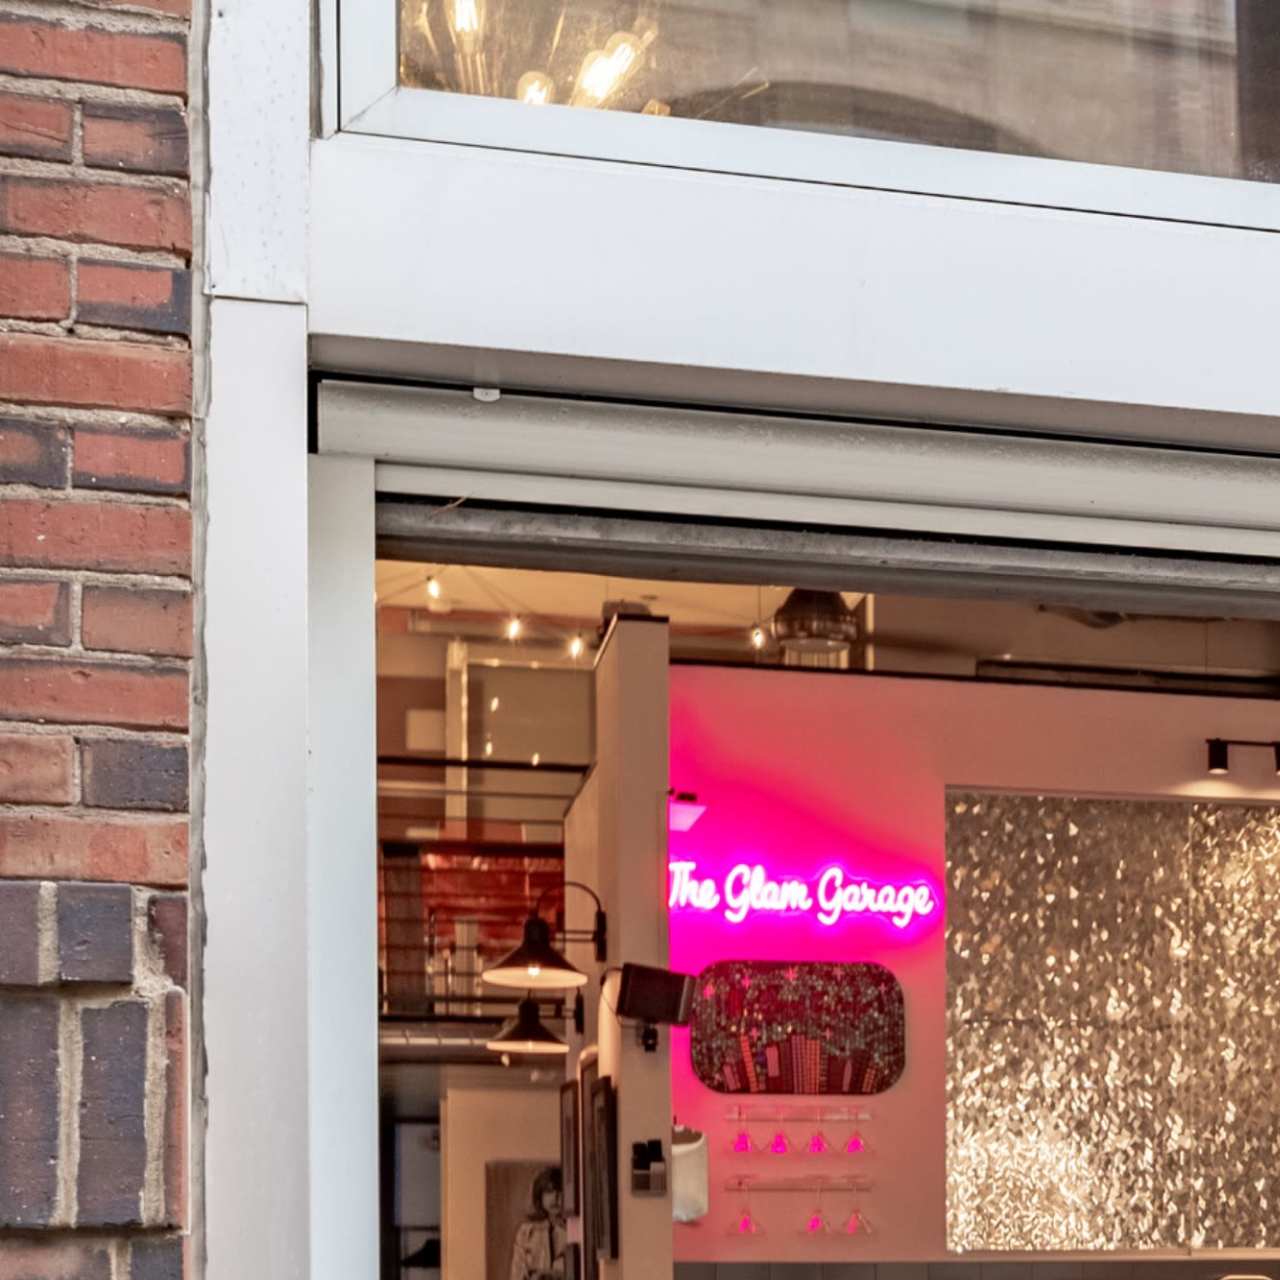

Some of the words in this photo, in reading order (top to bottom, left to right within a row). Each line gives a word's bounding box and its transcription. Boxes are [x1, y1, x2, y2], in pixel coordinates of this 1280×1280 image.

[668, 860, 720, 908] The
[724, 863, 813, 923] Glam
[817, 866, 935, 928] Garage
